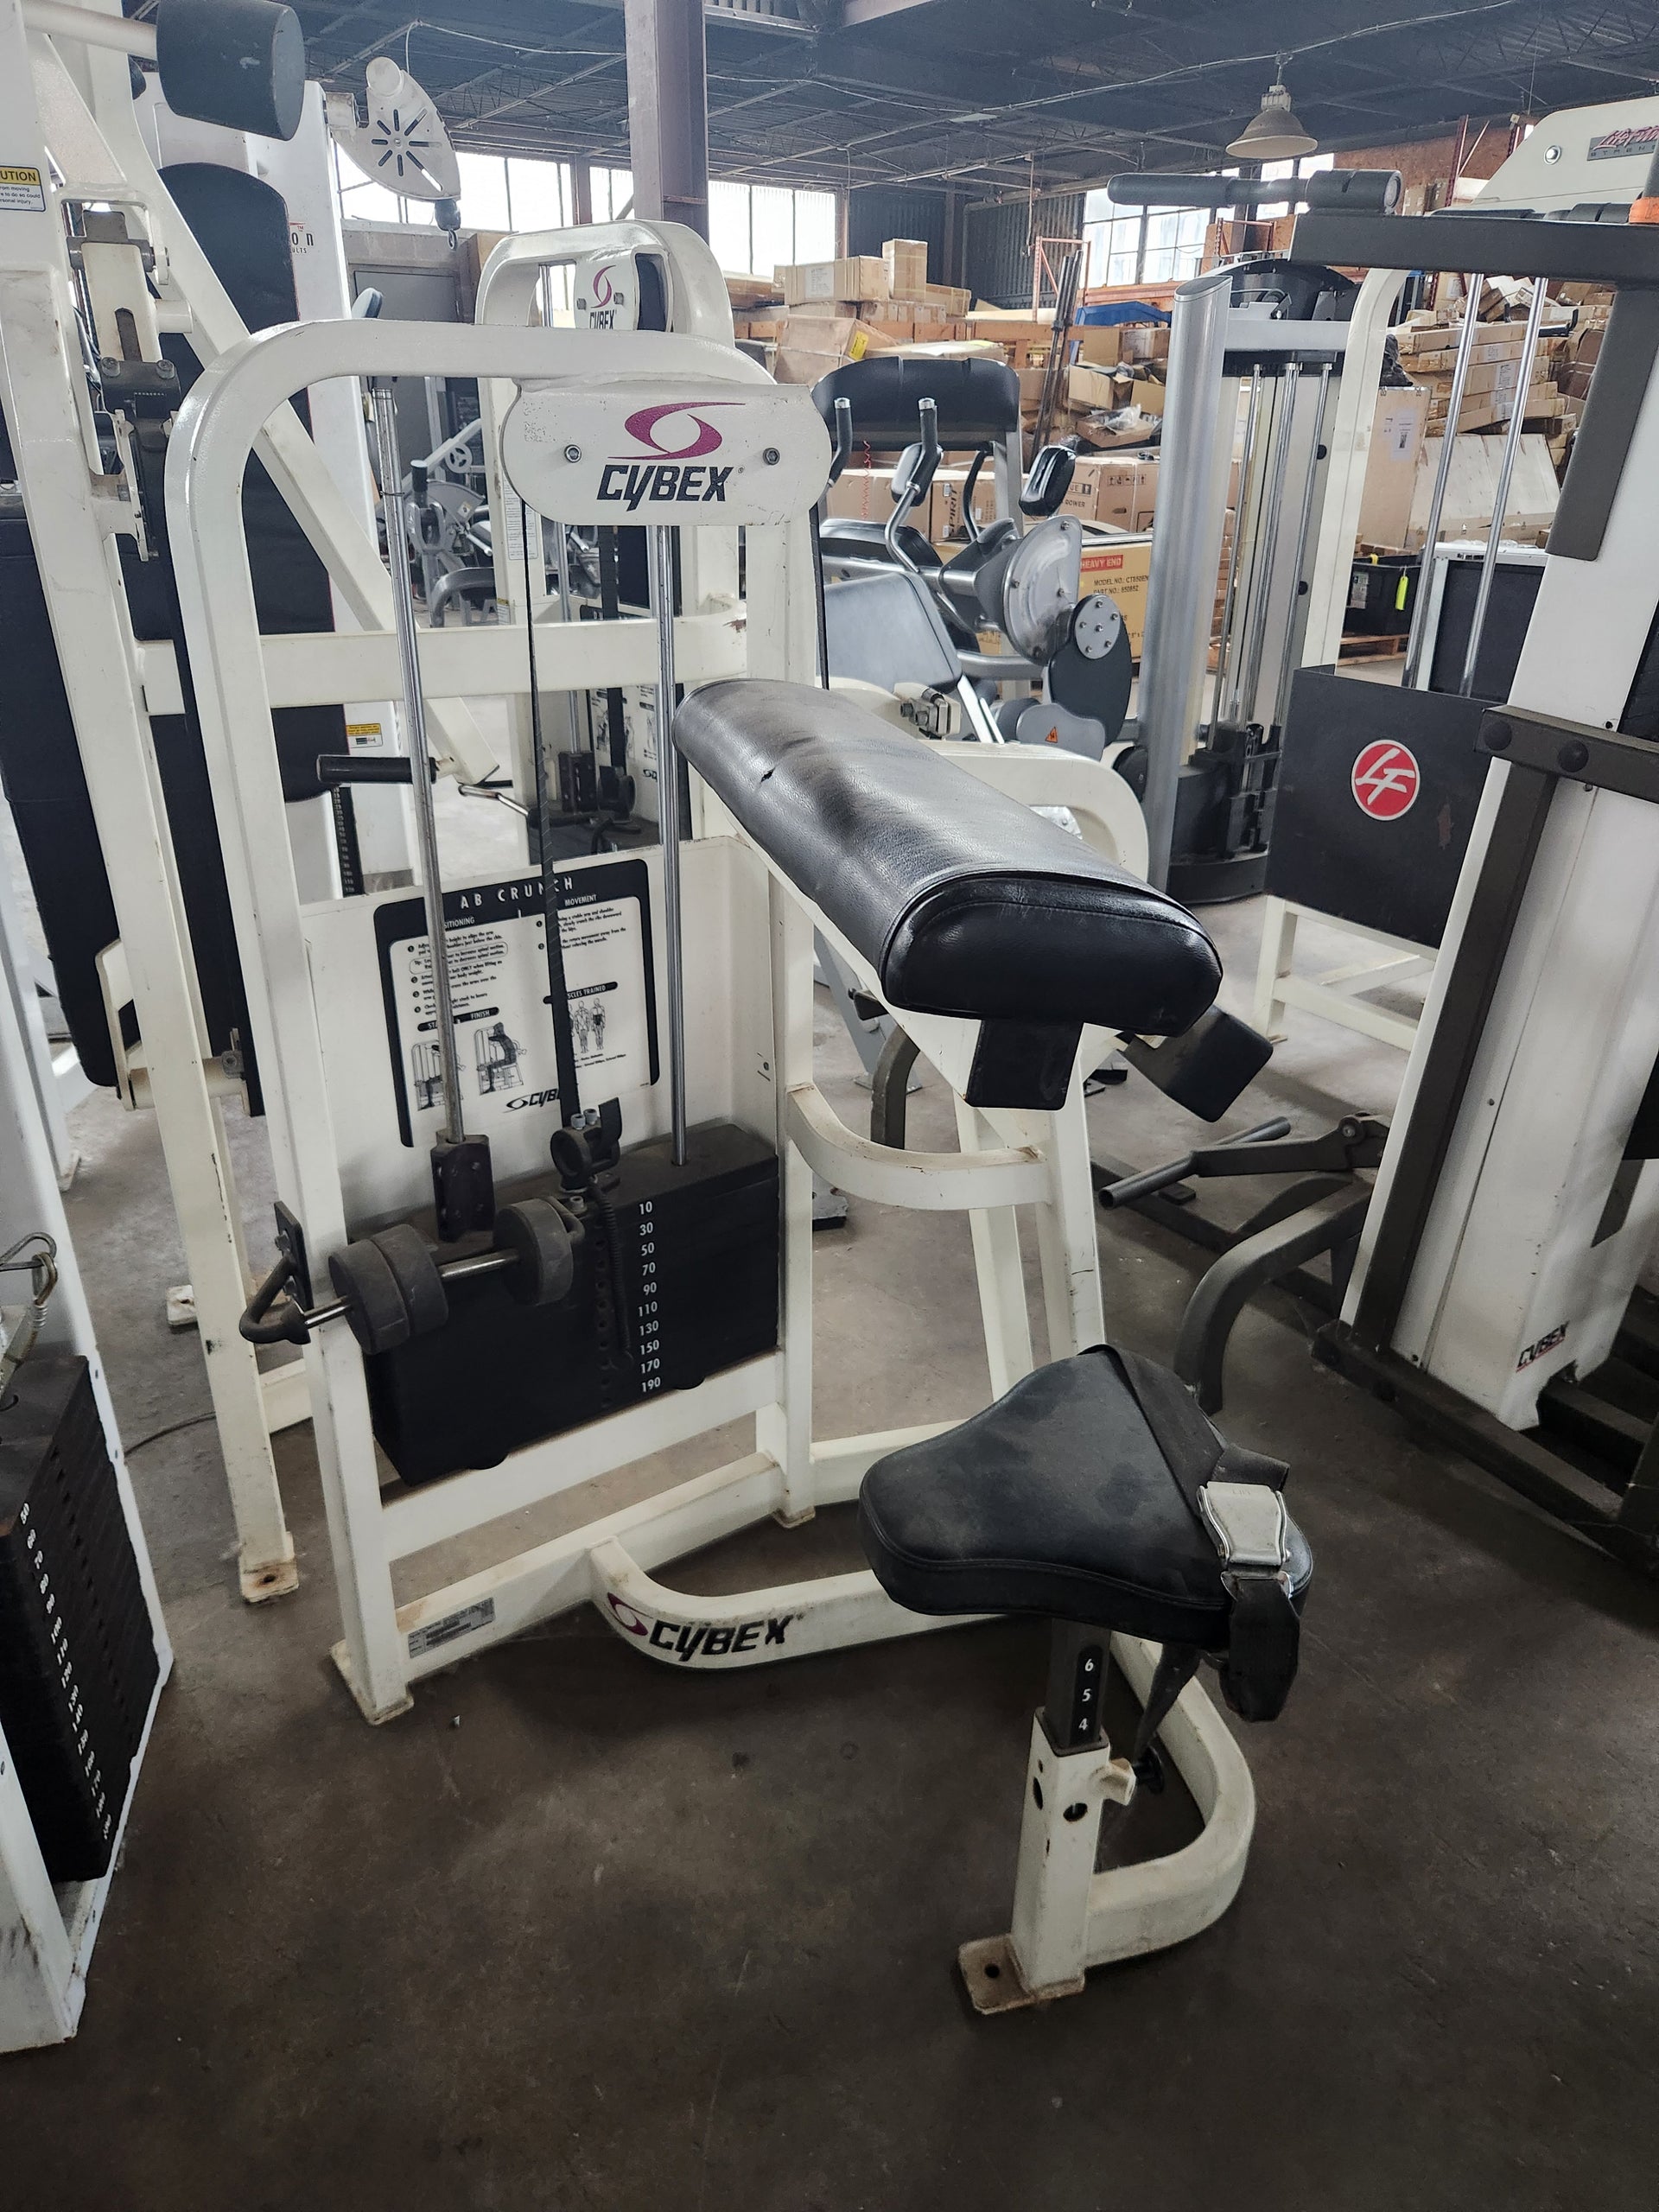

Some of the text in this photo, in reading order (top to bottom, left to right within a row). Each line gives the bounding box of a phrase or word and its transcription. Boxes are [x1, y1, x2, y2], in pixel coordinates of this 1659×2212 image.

[0, 170, 36, 181] UTION
[596, 464, 734, 512] CYBEX
[461, 892, 483, 909] AB
[564, 893, 597, 907] MOVEMENT
[444, 916, 475, 929] SITIONING
[583, 985, 607, 996] TRAINED
[471, 1010, 490, 1020] FINISH
[529, 1088, 559, 1107] CYB
[639, 1201, 653, 1215] 10
[639, 1222, 653, 1236] 30
[641, 1243, 655, 1256] 50
[642, 1262, 656, 1275] 70
[643, 1281, 657, 1295] 90
[638, 1301, 658, 1317] 110
[639, 1320, 658, 1336] 130
[640, 1339, 659, 1355] 150
[640, 1358, 660, 1374] 170
[641, 1376, 661, 1392] 190
[649, 1614, 794, 1662] CYBEX
[1084, 1658, 1094, 1672] 6
[1082, 1688, 1091, 1702] 5
[1078, 1718, 1089, 1731] 4
